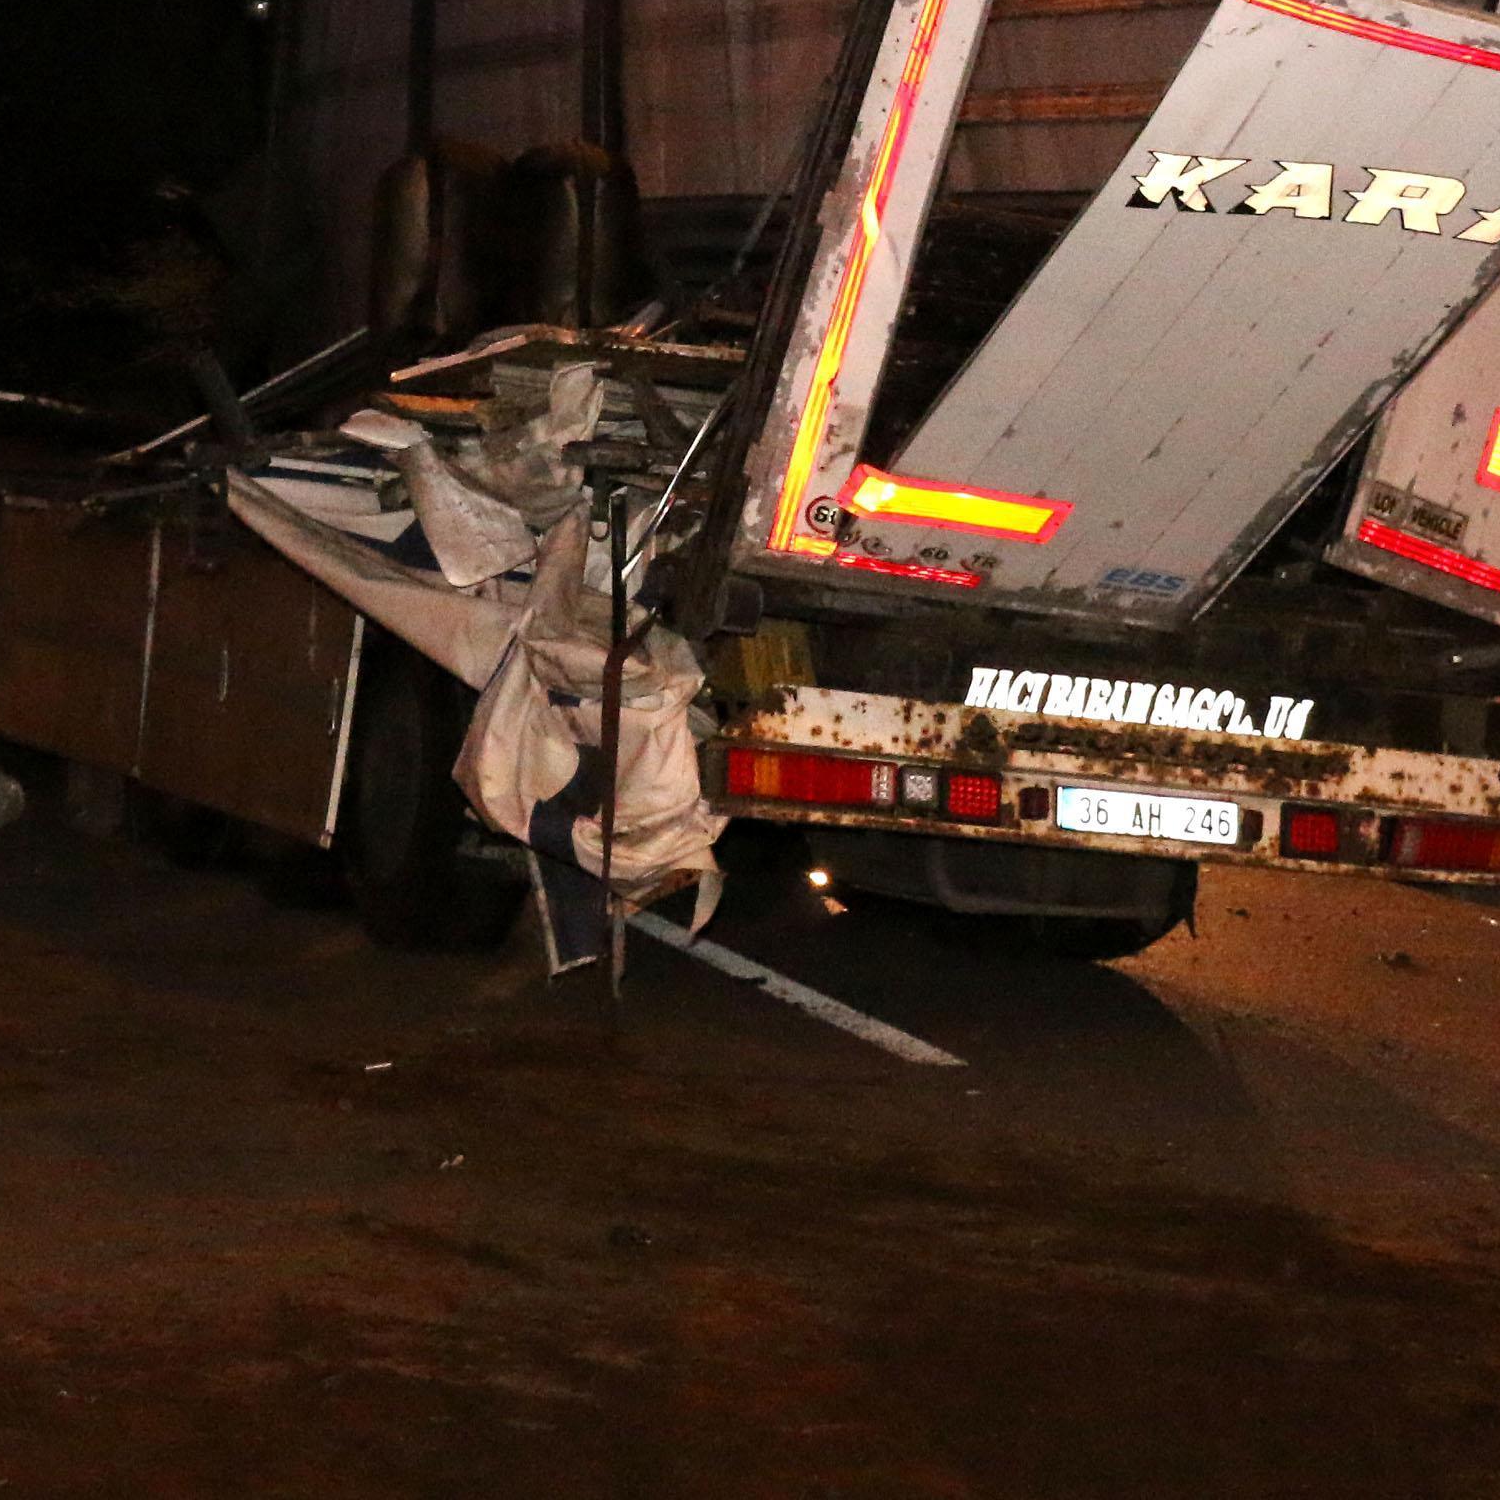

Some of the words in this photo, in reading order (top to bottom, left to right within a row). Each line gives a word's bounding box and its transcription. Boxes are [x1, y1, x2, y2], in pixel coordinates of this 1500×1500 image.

[964, 666, 1050, 713] HACI
[1042, 673, 1158, 724] BABAM
[1079, 796, 1109, 826] 36
[1131, 801, 1162, 835] AH
[1183, 805, 1231, 837] 246
